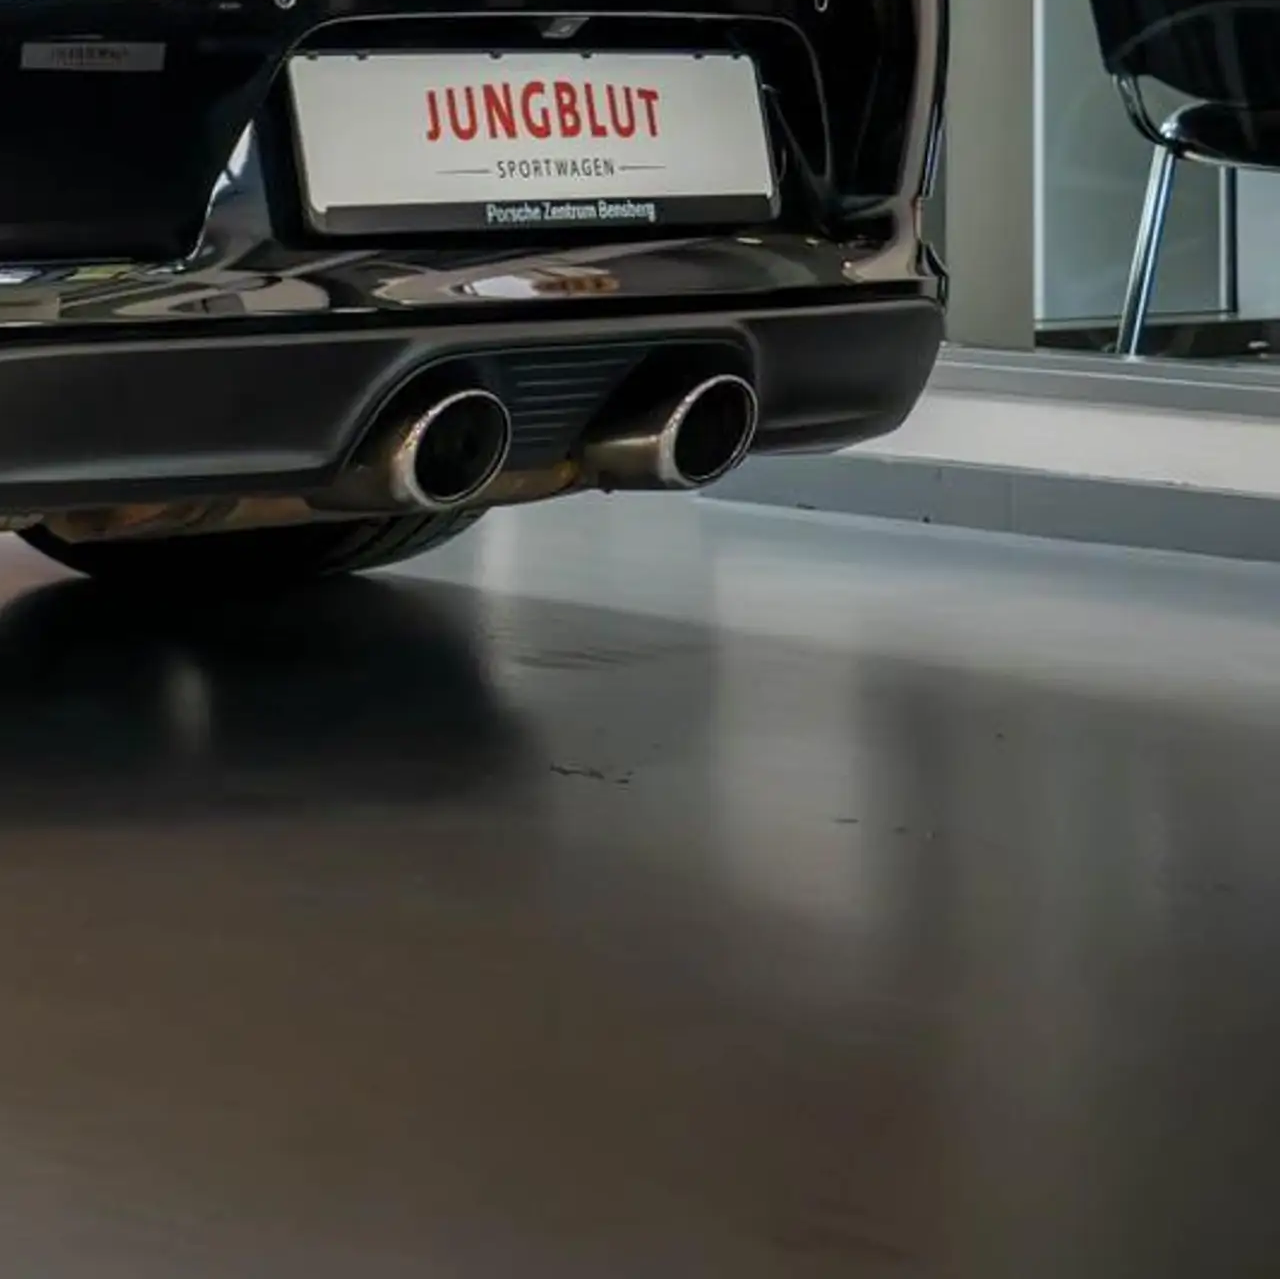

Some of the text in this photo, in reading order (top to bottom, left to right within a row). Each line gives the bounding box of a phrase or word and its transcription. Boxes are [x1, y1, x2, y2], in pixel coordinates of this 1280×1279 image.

[426, 81, 660, 141] JUNGBLUT
[497, 158, 614, 179] SPORTWAGEN
[486, 199, 656, 223] Porsche Zentrum Bensberg
